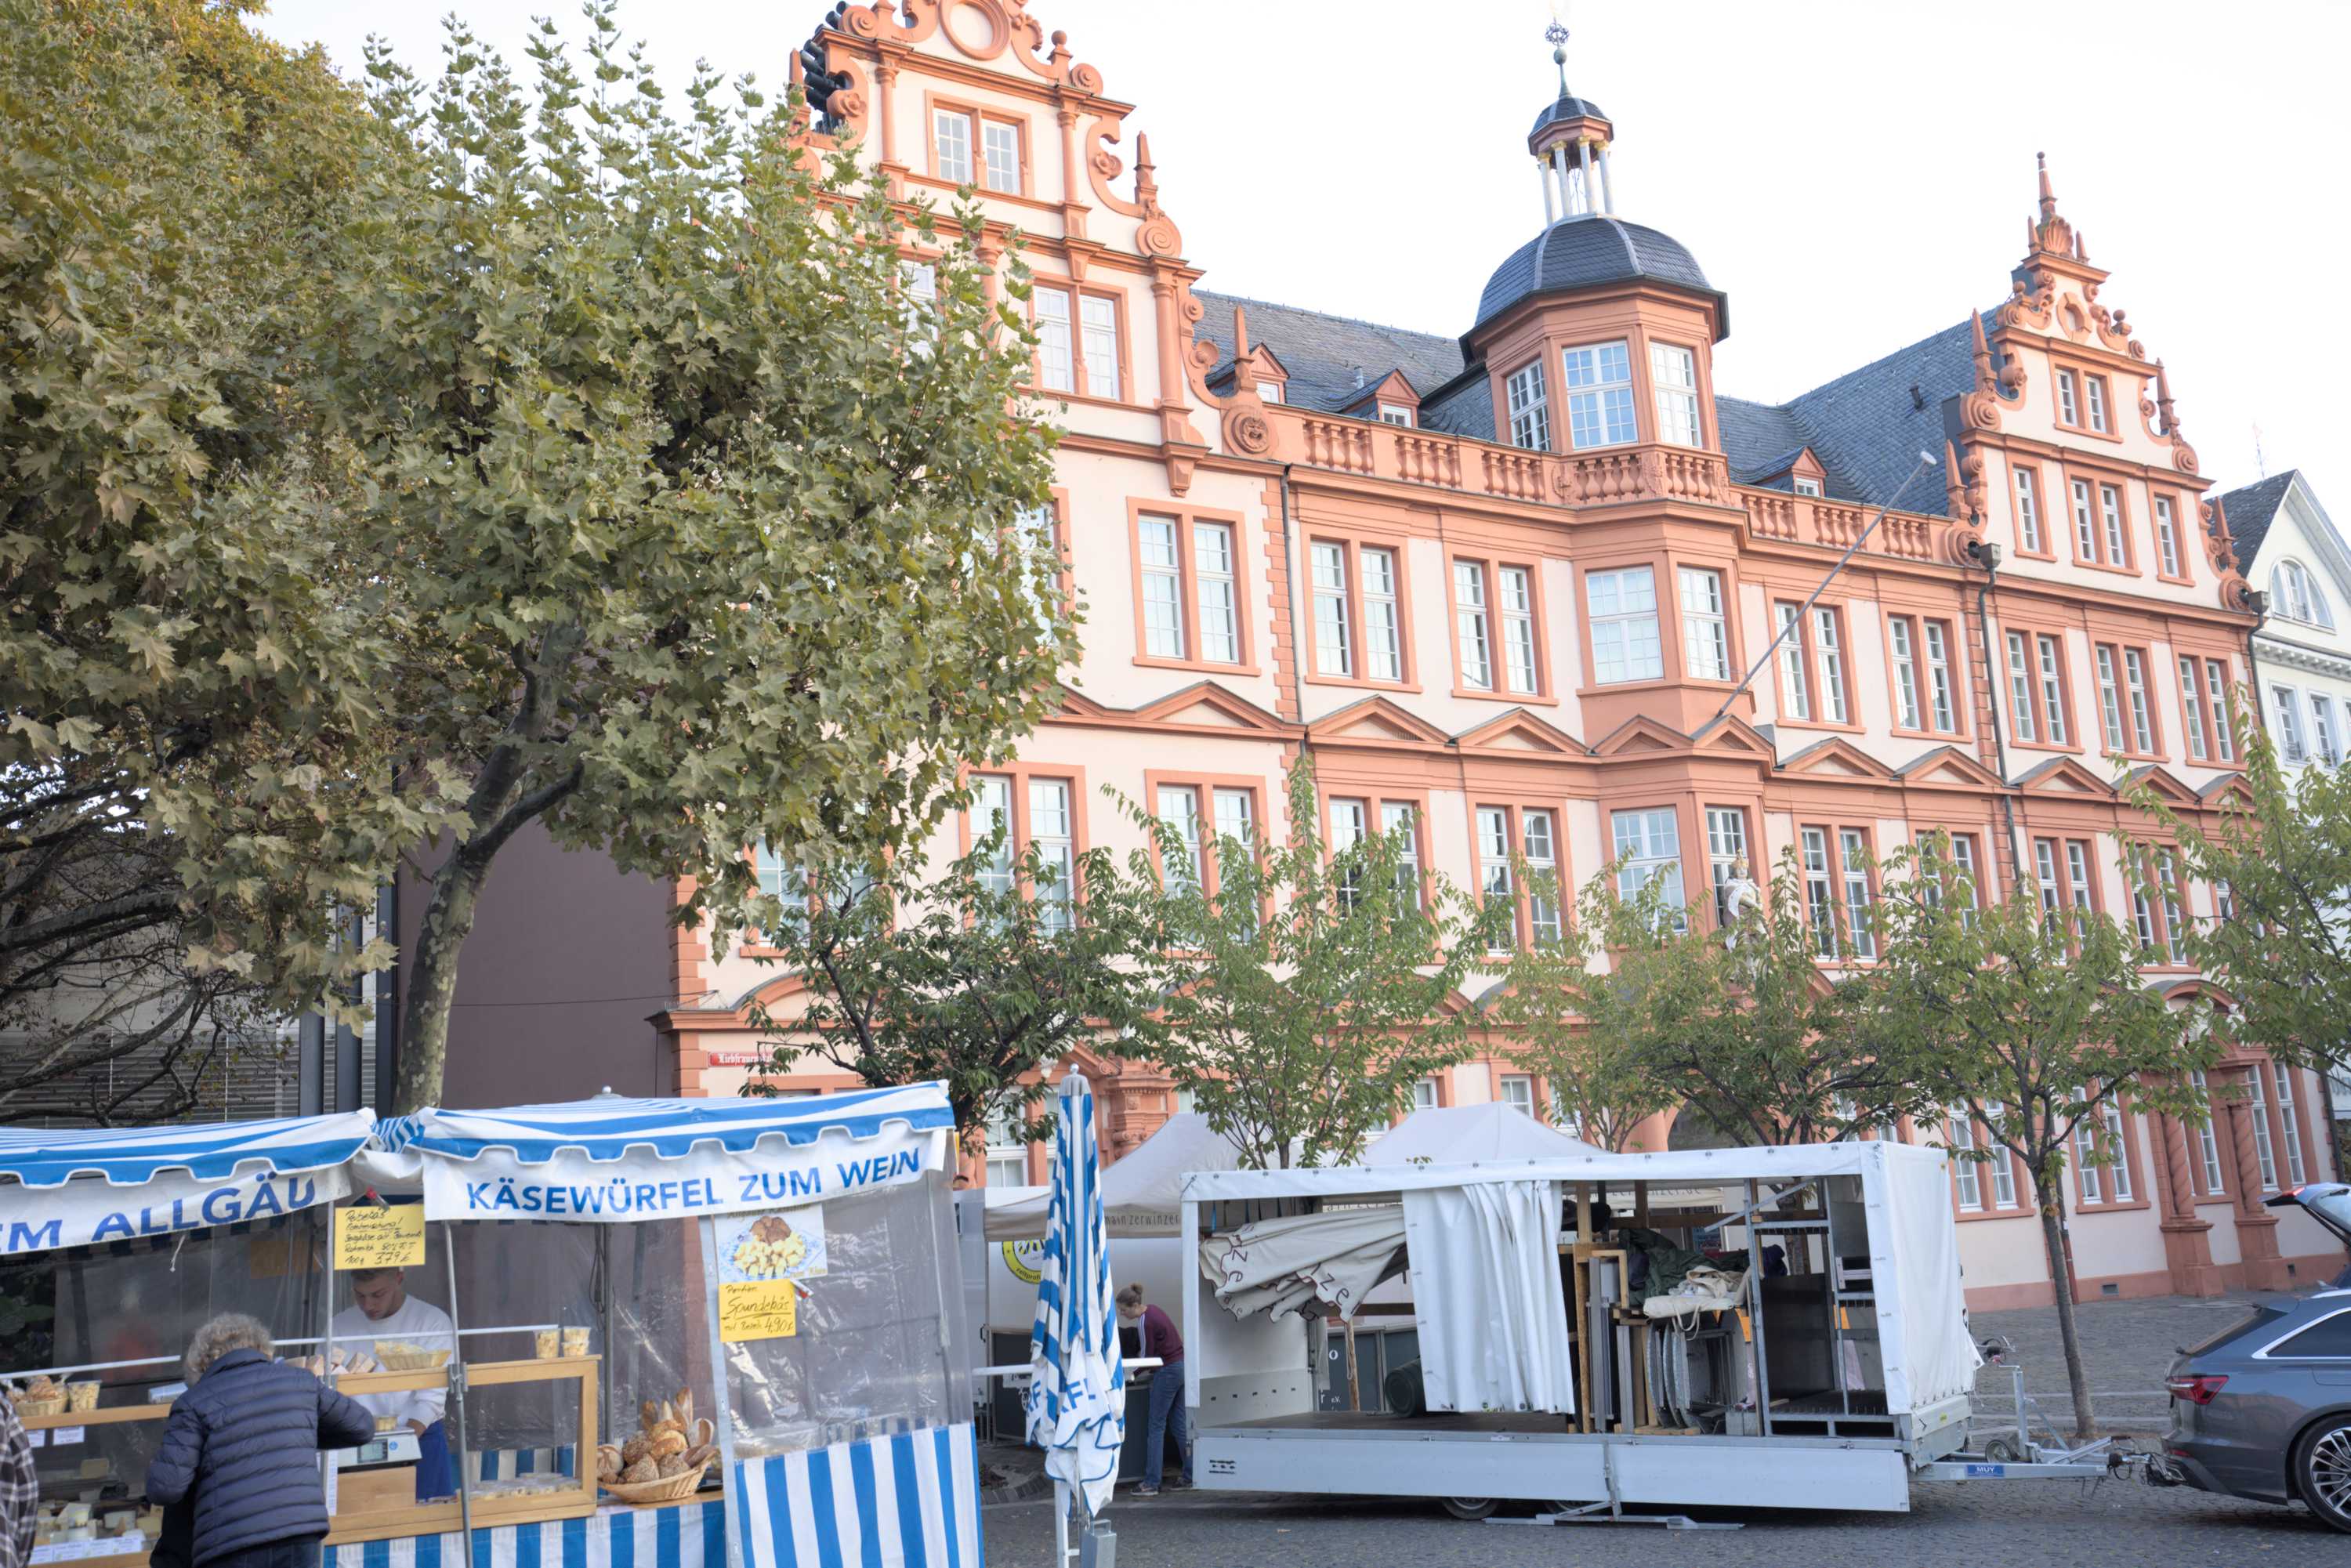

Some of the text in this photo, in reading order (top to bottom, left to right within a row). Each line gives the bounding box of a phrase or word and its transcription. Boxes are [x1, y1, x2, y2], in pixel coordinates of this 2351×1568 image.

[0, 1171, 314, 1252] M ALLGÄU
[469, 1146, 921, 1213] KÄSEWÜRFEL ZUM WEIN
